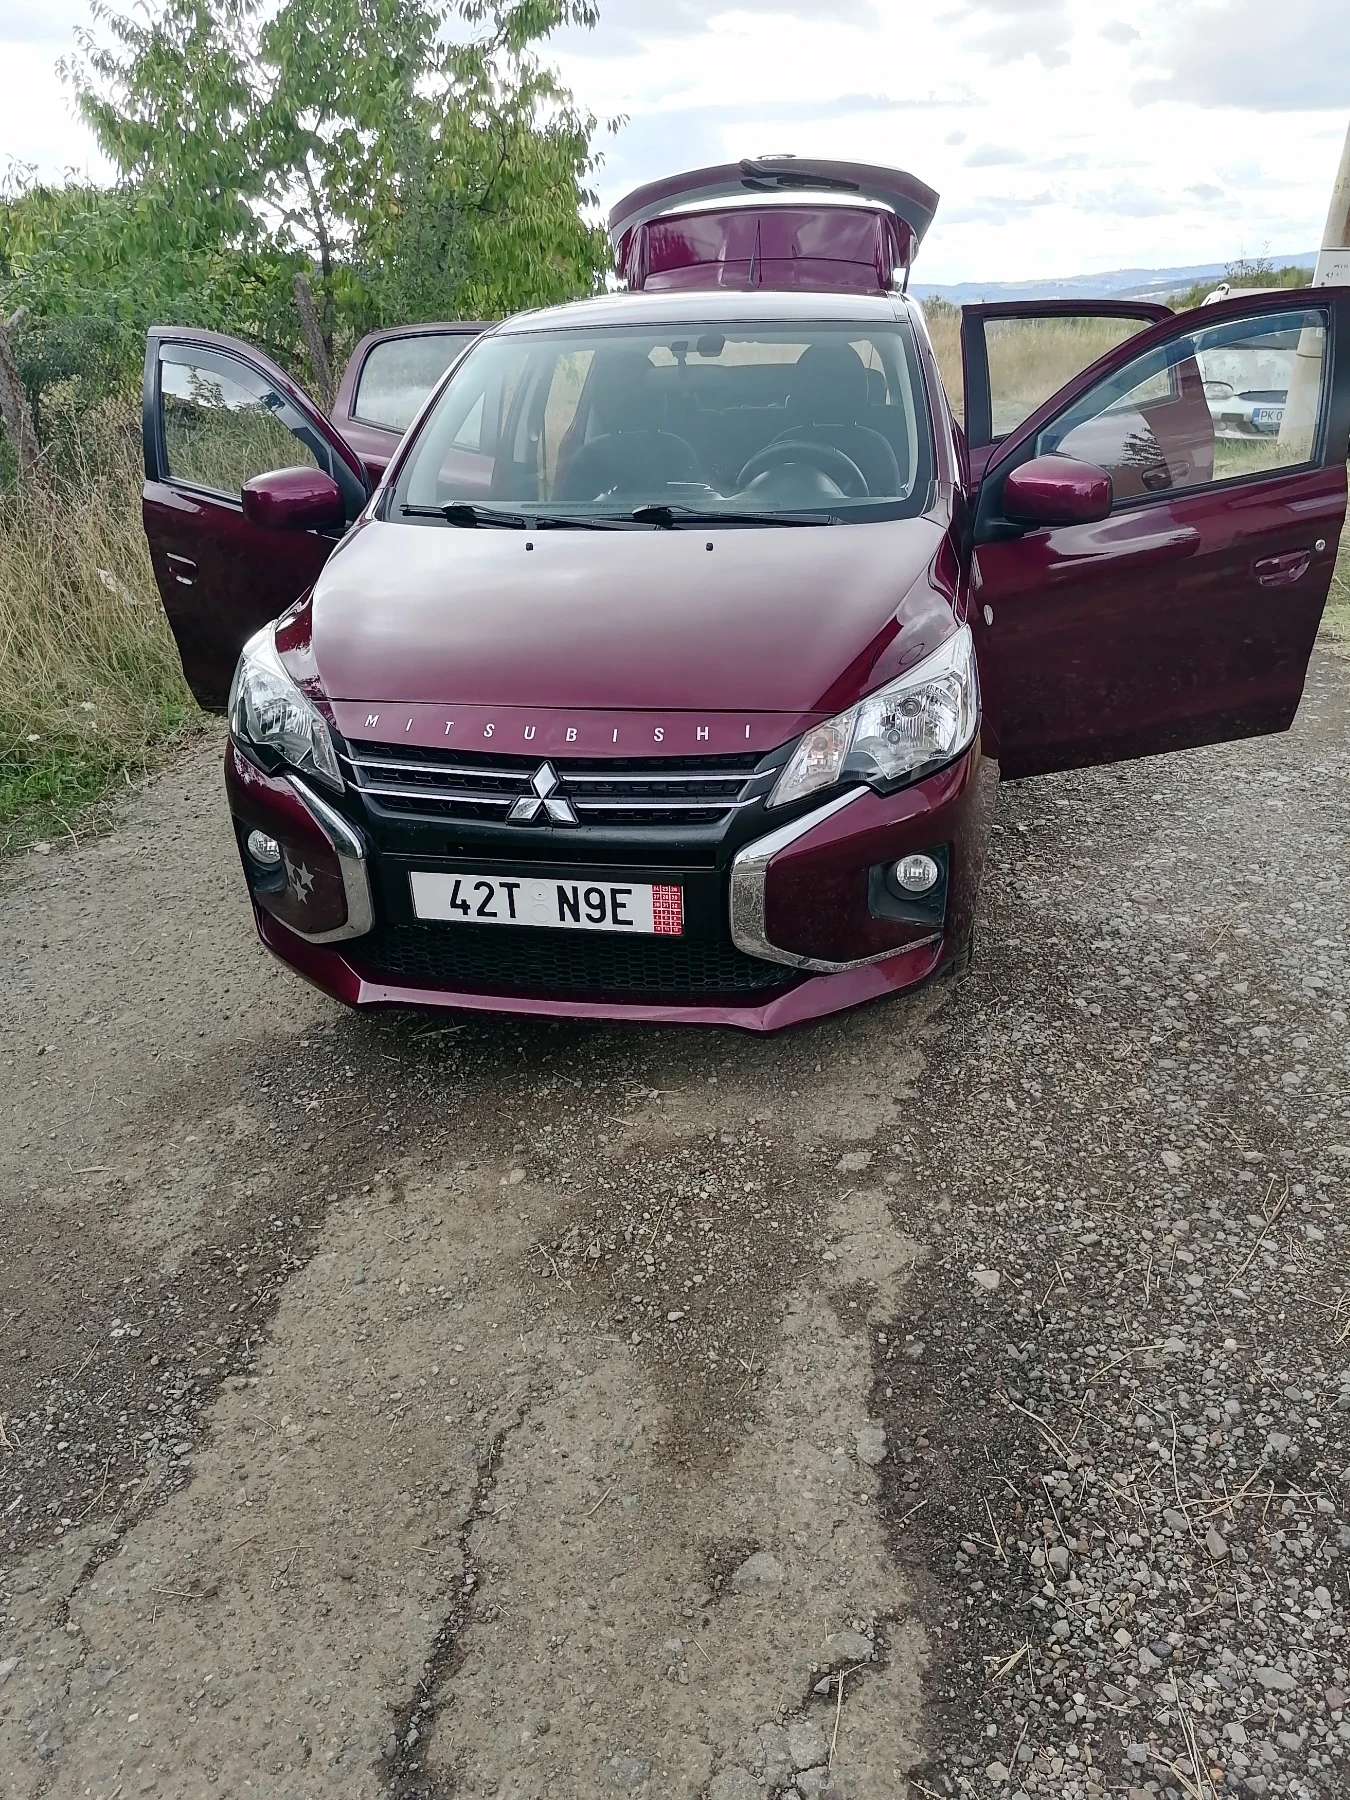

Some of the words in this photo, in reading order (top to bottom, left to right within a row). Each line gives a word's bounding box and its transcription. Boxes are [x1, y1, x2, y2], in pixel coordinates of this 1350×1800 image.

[1260, 411, 1274, 421] PK
[364, 714, 750, 743] MITSUBISHI
[449, 879, 521, 919] 42T
[556, 884, 634, 926] N9E
